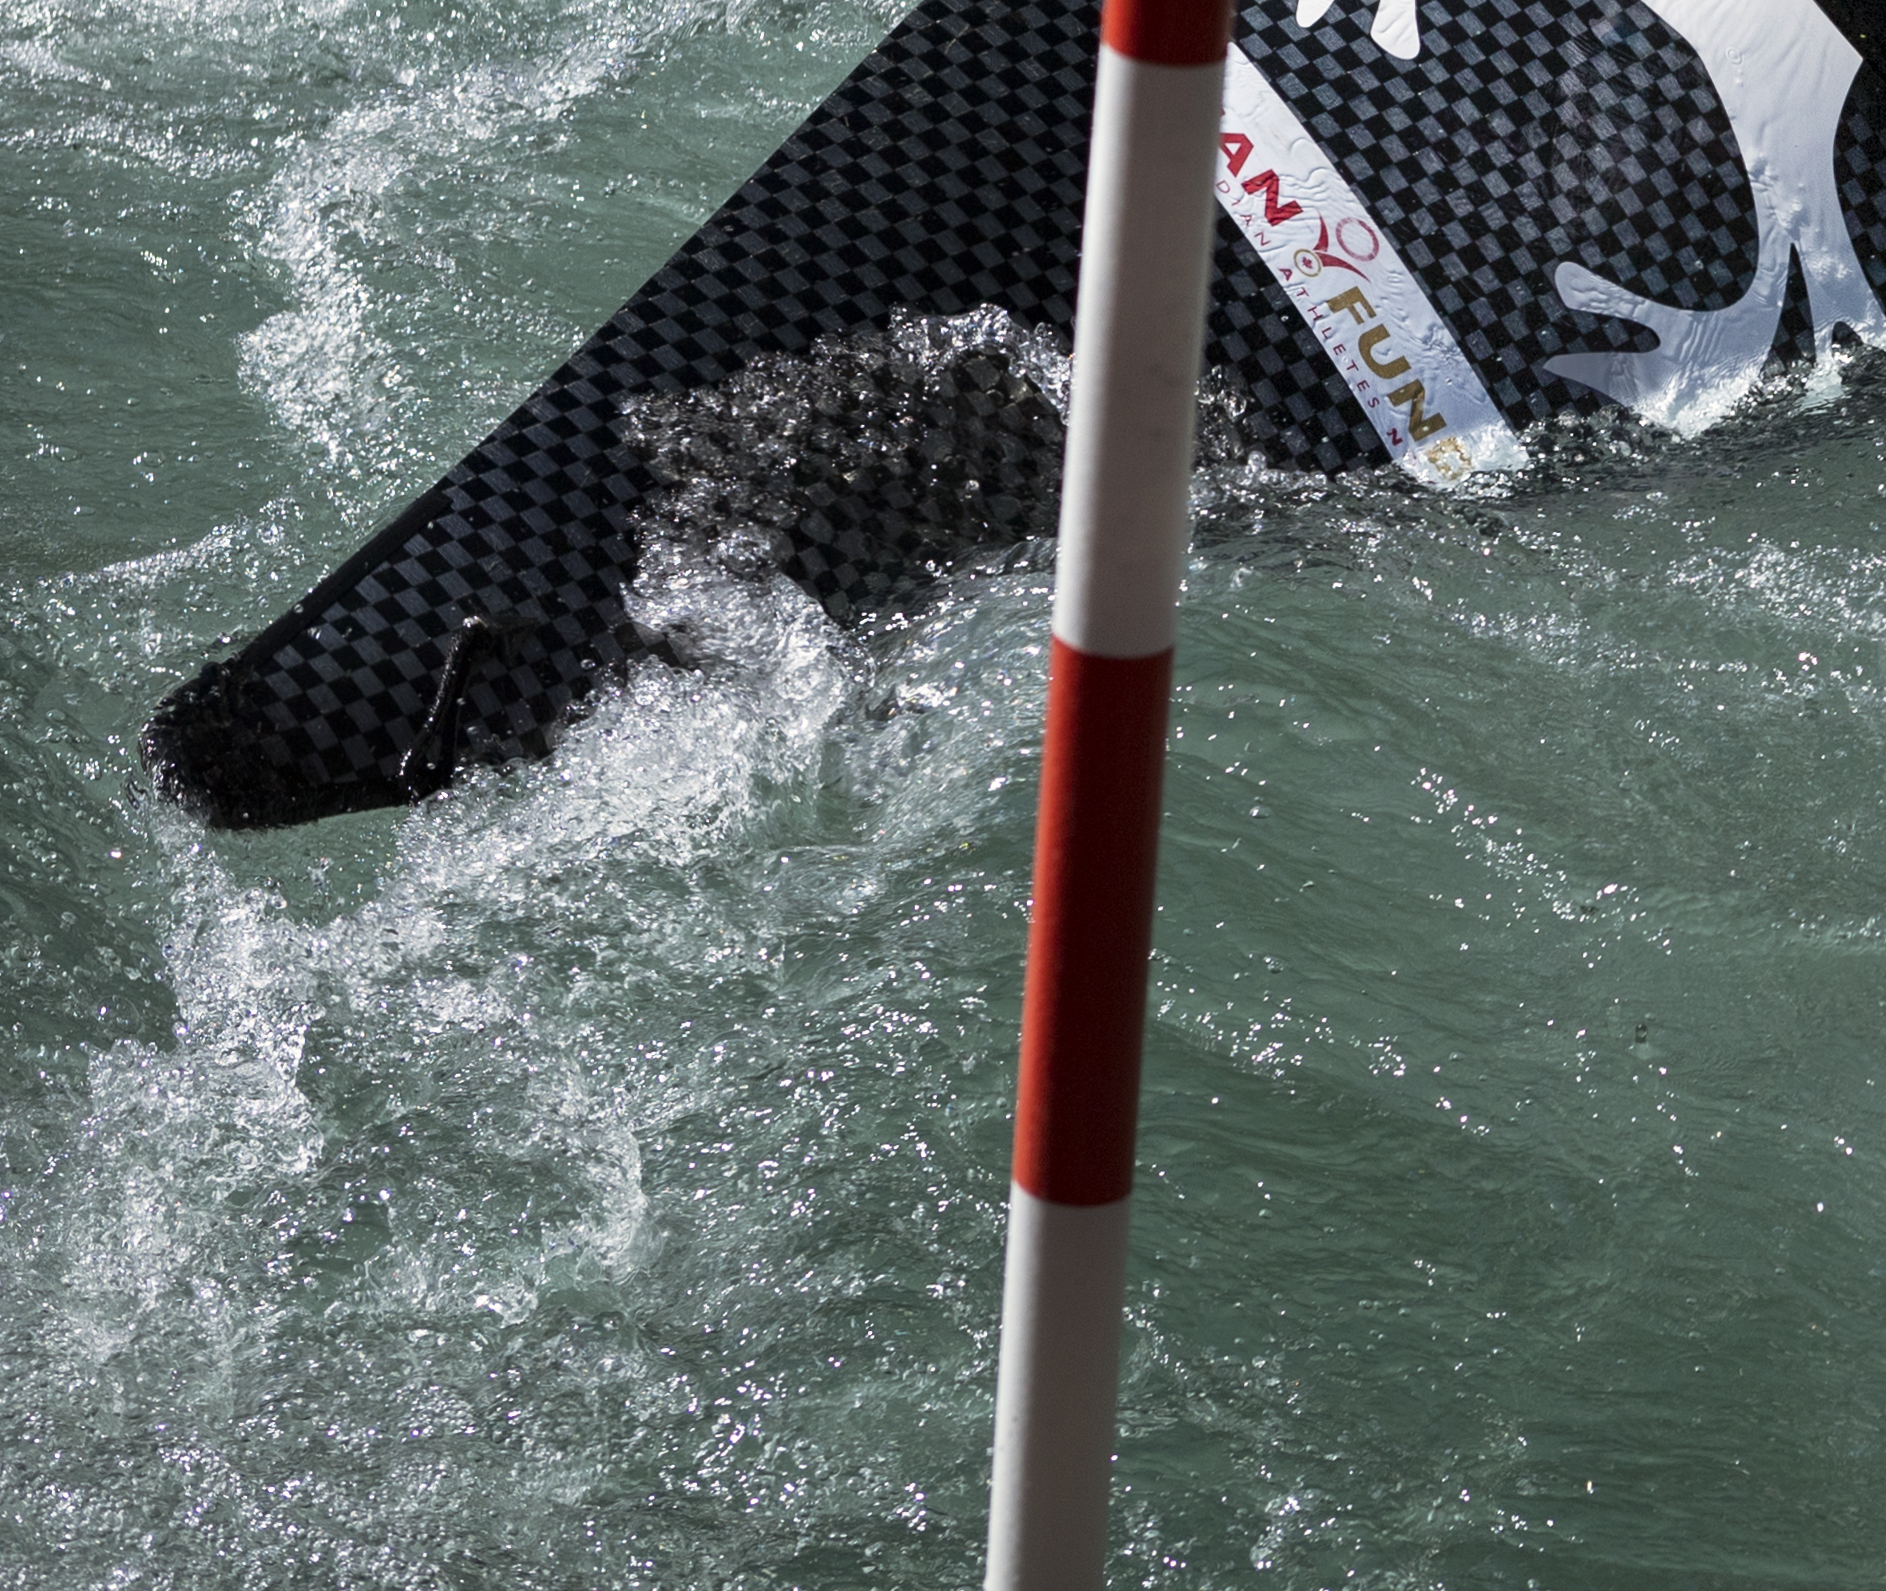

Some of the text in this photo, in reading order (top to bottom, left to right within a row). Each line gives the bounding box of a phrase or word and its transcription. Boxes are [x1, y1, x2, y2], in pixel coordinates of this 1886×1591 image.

[1220, 108, 1304, 227] AN
[1216, 180, 1380, 408] DIAN ATHLETES
